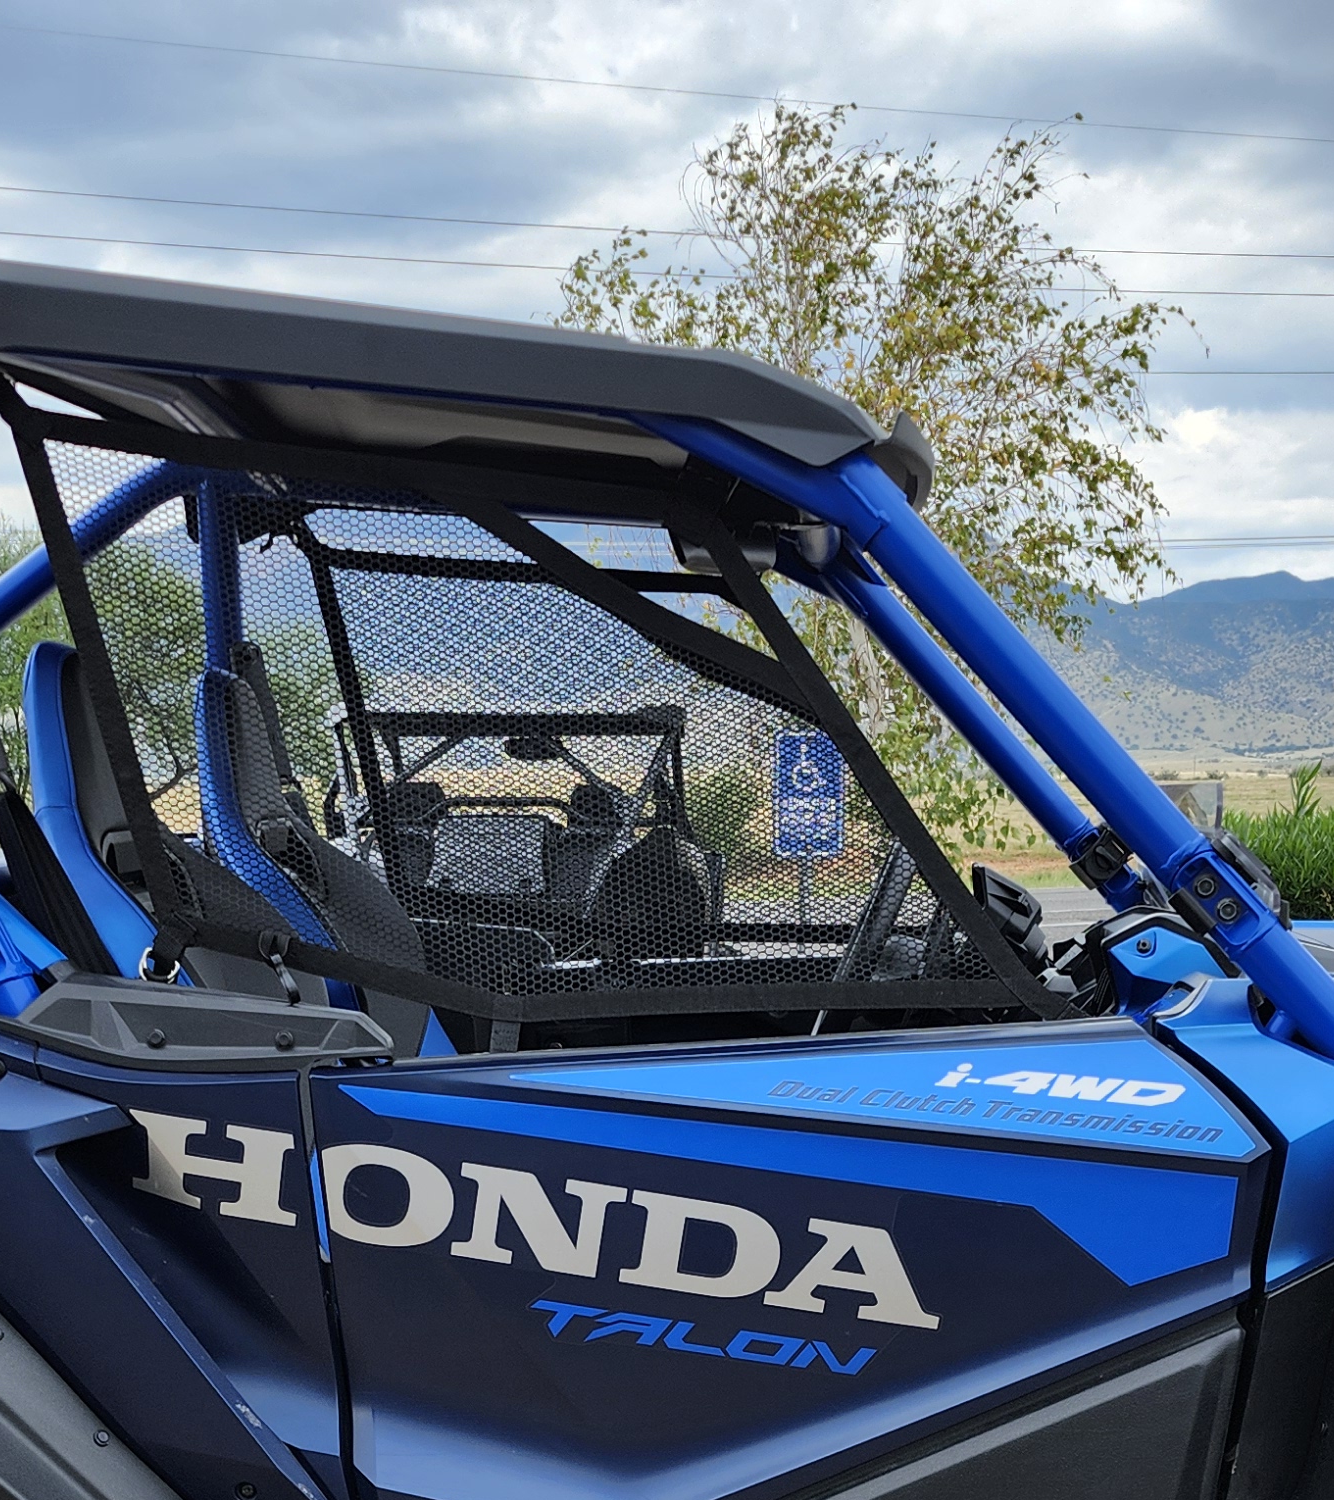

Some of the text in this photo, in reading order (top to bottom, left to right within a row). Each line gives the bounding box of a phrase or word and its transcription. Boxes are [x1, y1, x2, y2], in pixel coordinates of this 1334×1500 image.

[766, 1079, 1225, 1144] Dual Clutch Transmission
[934, 1063, 1187, 1106] i-4WD
[128, 1107, 940, 1330] HONDA
[529, 1299, 878, 1376] TALON
